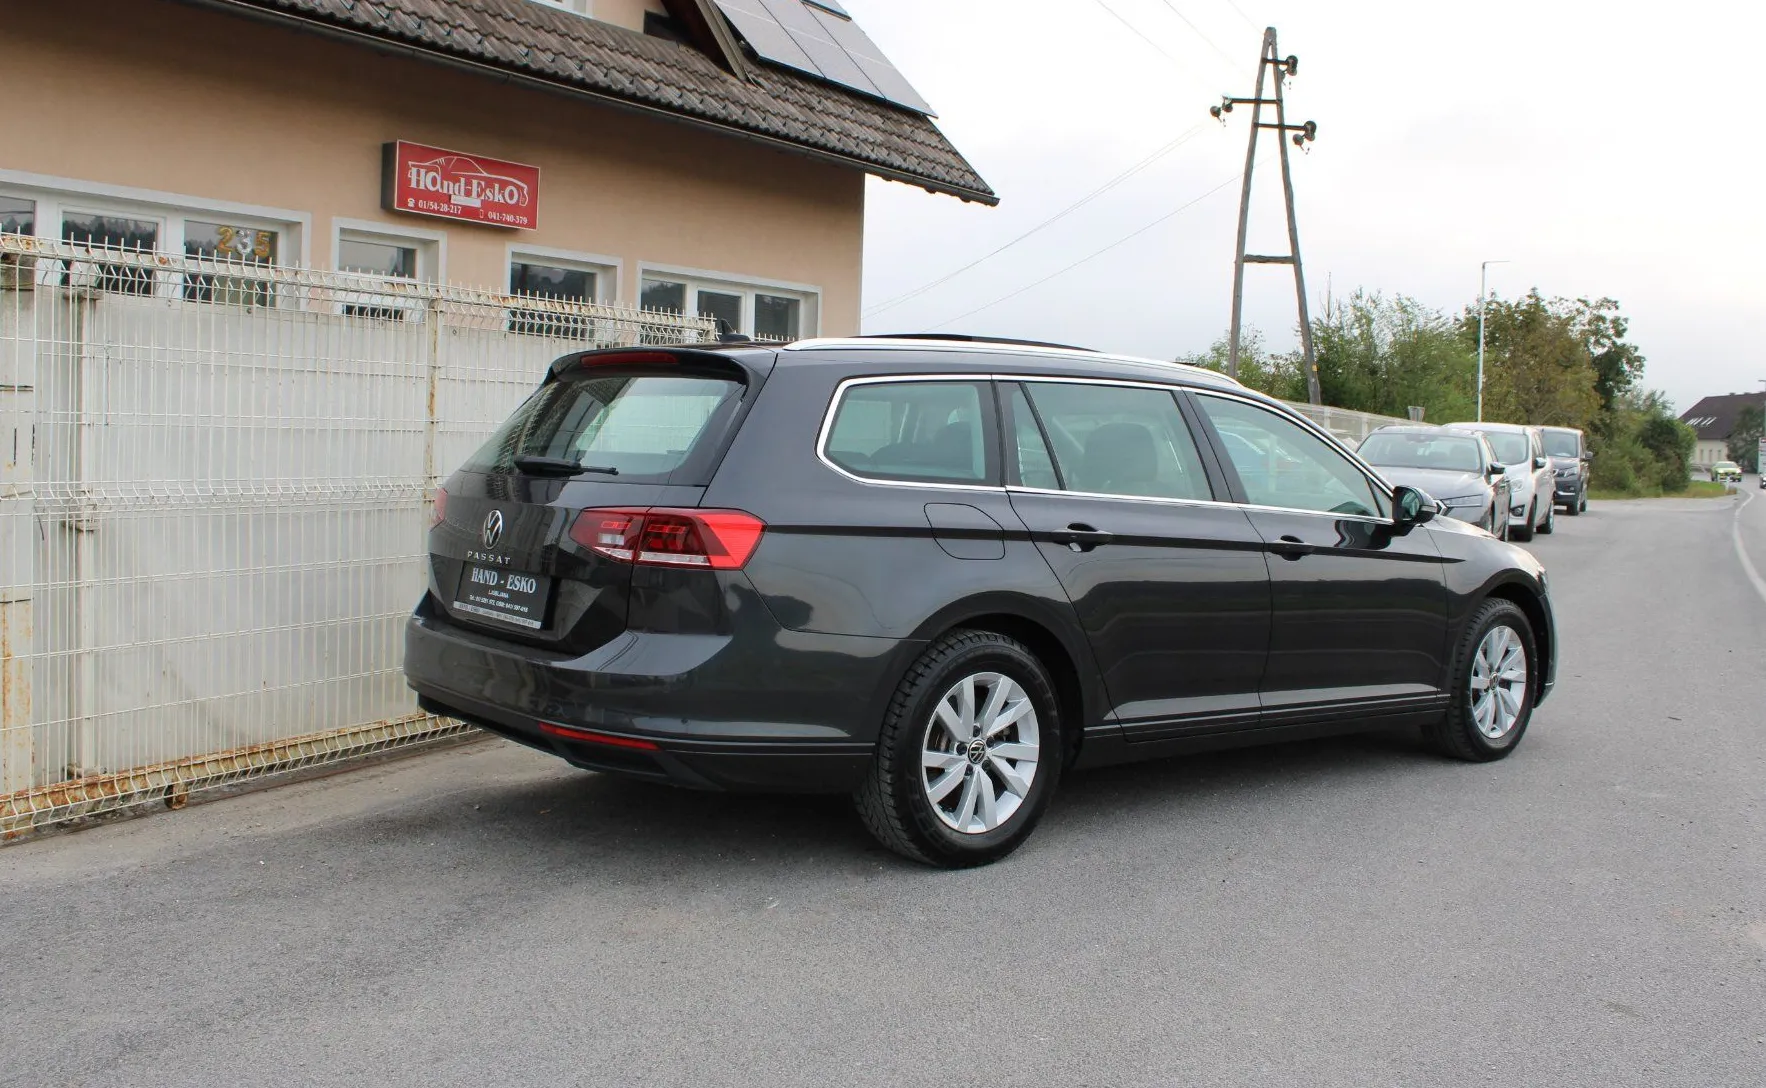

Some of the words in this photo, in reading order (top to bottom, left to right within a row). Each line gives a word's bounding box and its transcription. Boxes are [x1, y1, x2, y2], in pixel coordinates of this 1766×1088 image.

[467, 551, 511, 565] PASSAT
[471, 567, 498, 586] HAND
[506, 574, 537, 594] ESKO
